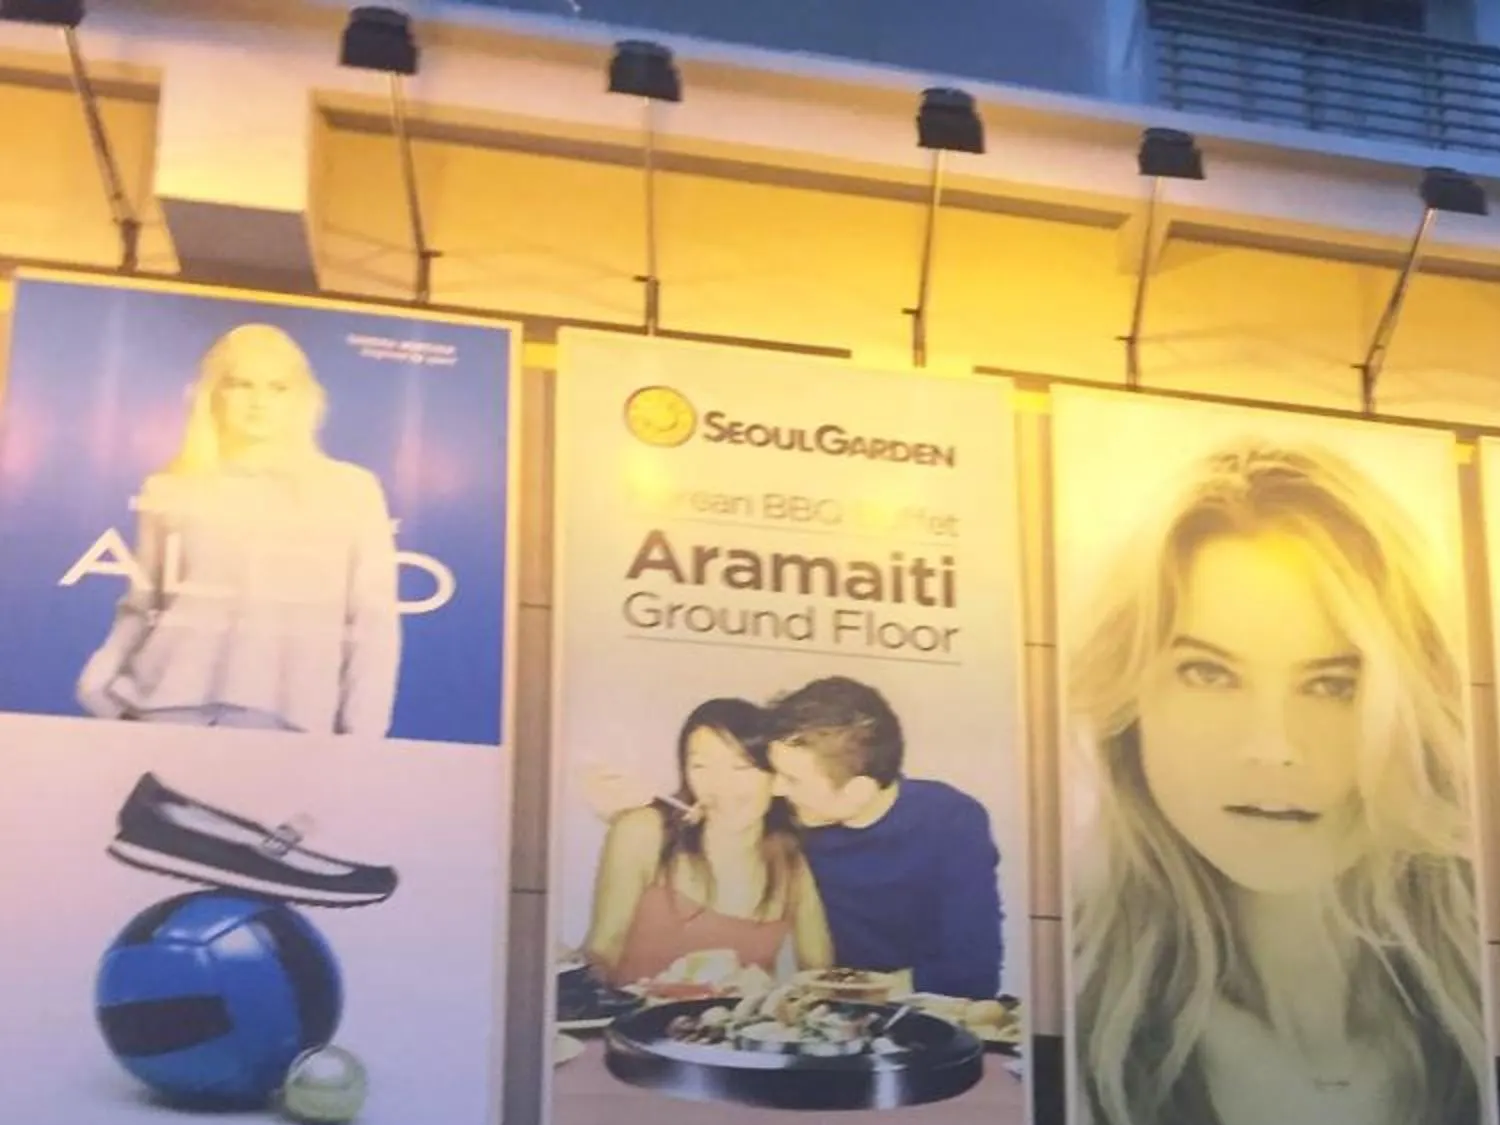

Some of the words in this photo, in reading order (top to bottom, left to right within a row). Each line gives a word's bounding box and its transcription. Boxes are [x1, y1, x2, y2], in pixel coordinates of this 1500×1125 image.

[625, 529, 956, 608] Aramaiti
[623, 591, 814, 641] Ground
[833, 608, 959, 654] Floor
